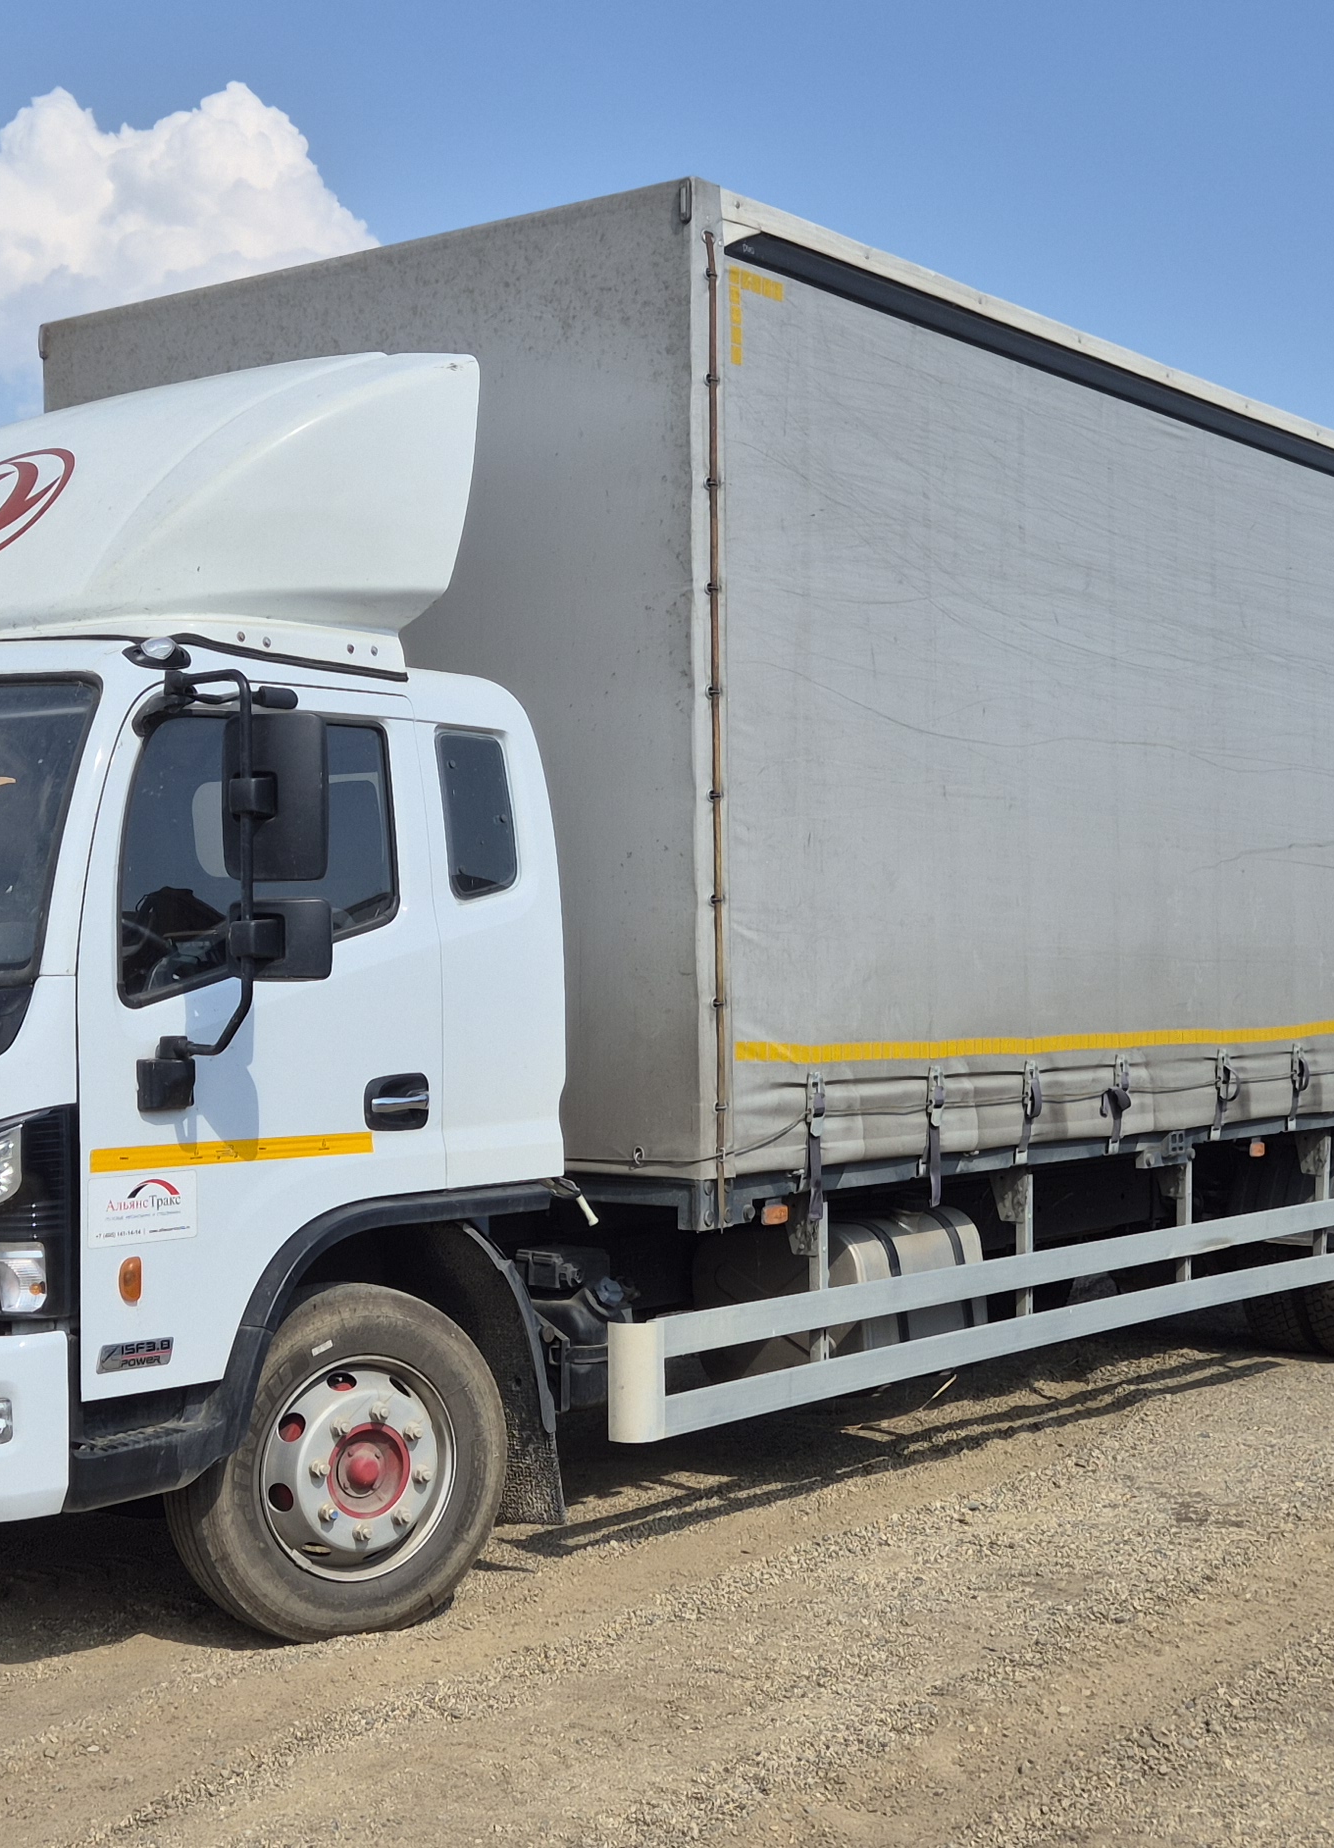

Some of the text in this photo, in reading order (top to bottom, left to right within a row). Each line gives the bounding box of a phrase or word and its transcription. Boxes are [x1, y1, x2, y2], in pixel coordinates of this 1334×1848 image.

[105, 1194, 181, 1212] АльянсТракс
[121, 1340, 171, 1356] ISF3.8
[120, 1355, 162, 1368] POWER
